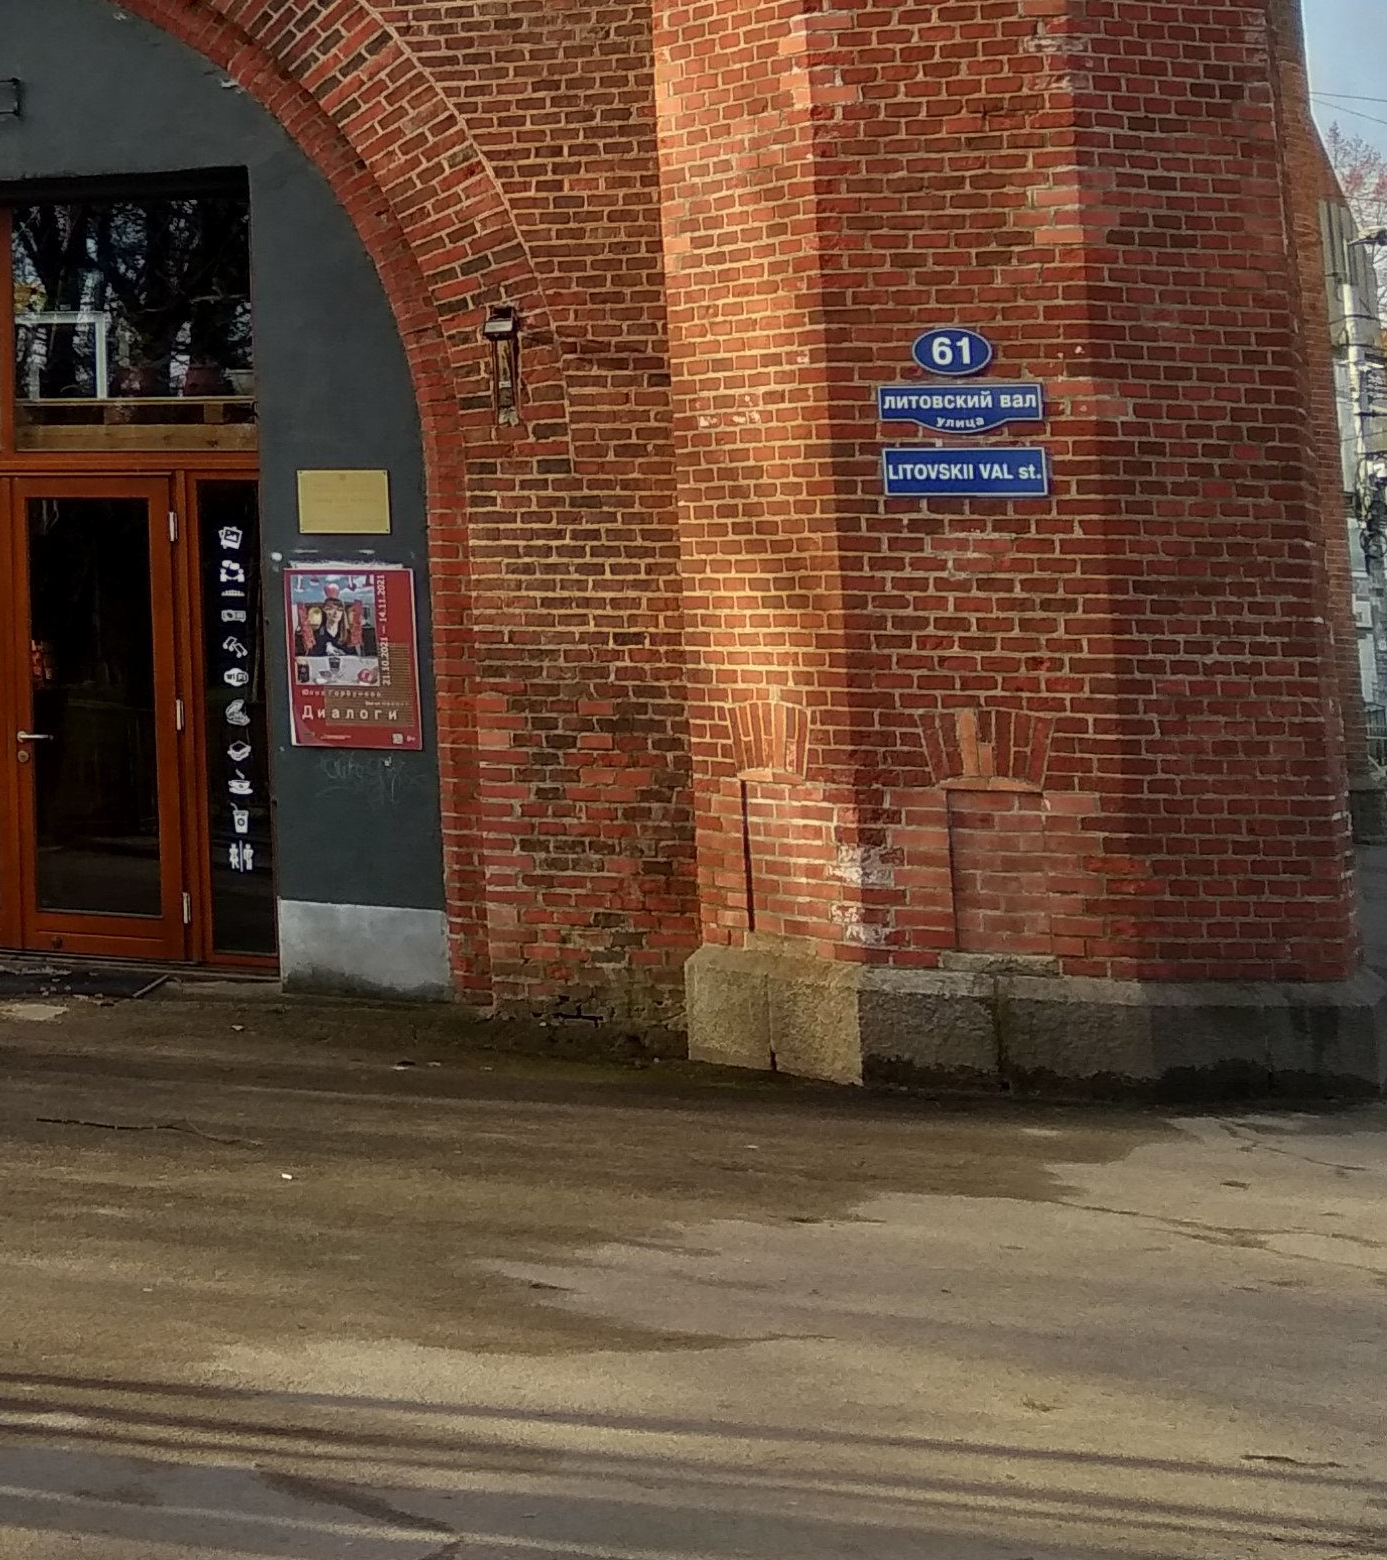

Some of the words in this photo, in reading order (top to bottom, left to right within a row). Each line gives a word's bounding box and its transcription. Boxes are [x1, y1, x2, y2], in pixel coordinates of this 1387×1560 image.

[931, 336, 972, 365] 61
[1000, 393, 1037, 408] вал
[936, 416, 985, 429] улица
[888, 464, 974, 480] LITOVSKII
[979, 463, 1014, 479] VAL
[1018, 464, 1042, 479] st.
[377, 575, 387, 622] 14.11.2021
[380, 637, 391, 686] 21.10.2021
[302, 704, 397, 720] Диалоги
